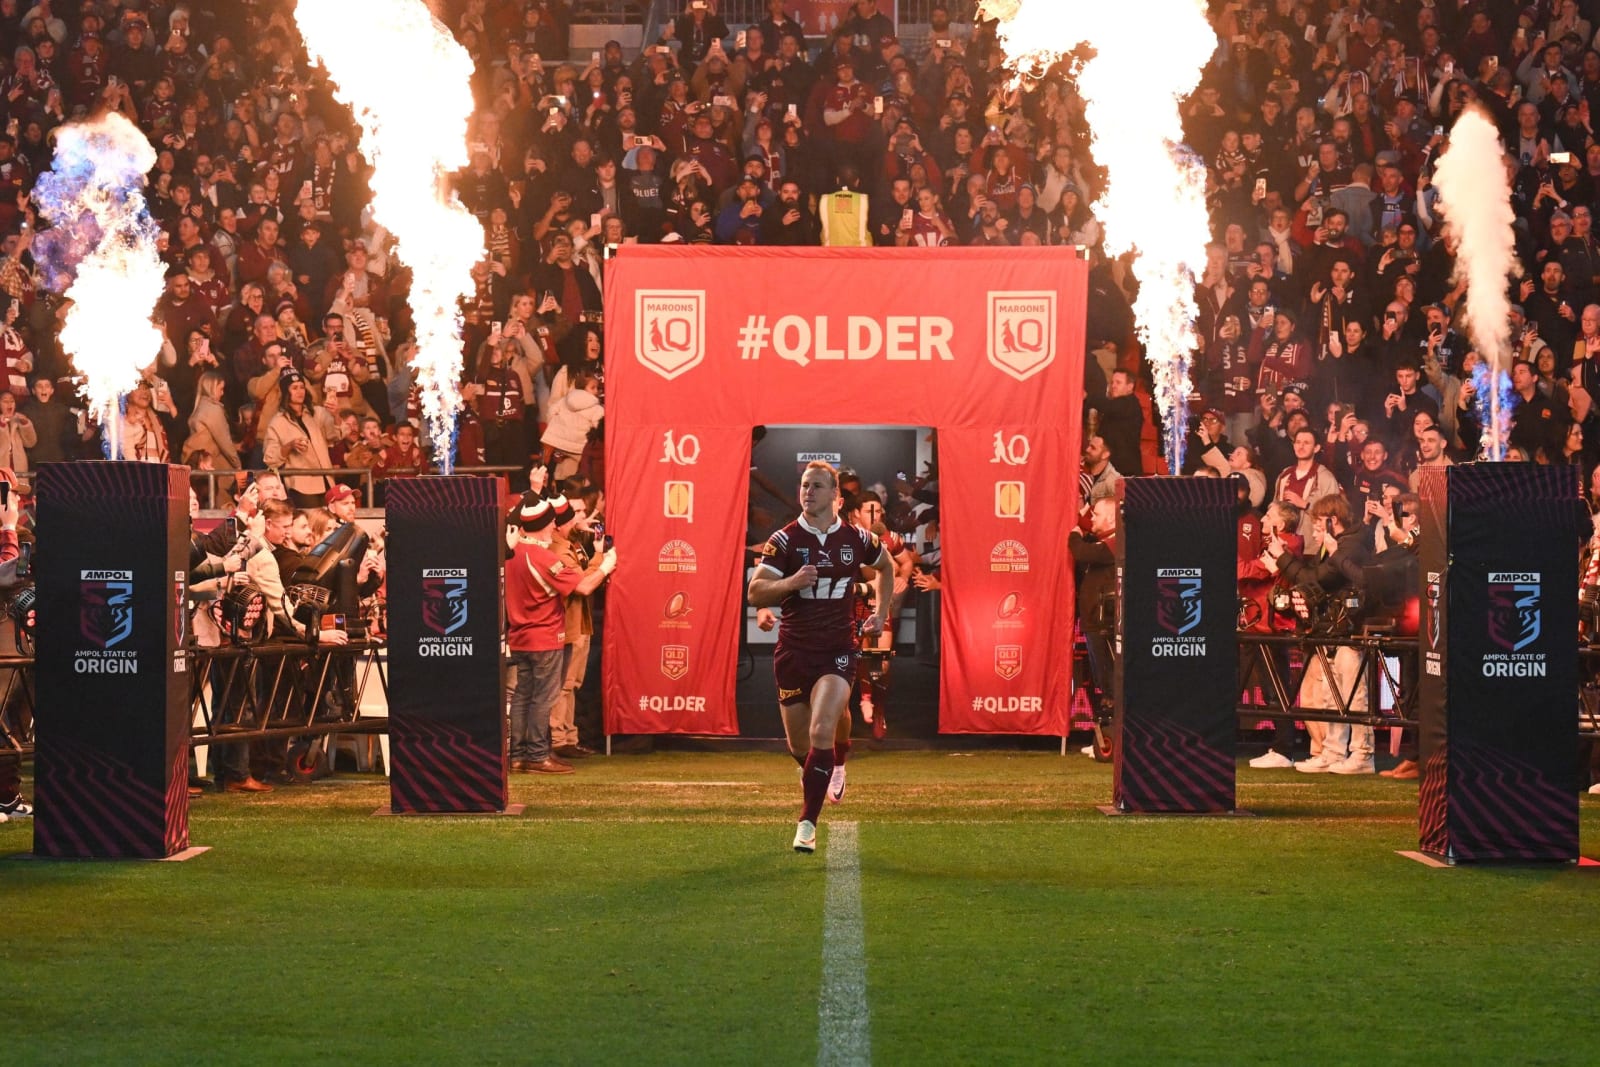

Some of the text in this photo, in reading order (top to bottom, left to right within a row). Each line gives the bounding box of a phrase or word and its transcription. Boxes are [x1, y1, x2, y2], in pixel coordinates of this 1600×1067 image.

[647, 303, 694, 312] MAROONS
[999, 304, 1046, 313] MAROONS
[737, 314, 955, 368] #QLDER
[85, 571, 130, 580] AMPOL
[1492, 573, 1537, 582] AMPOL
[102, 650, 126, 658] STATE
[127, 650, 137, 658] OF
[419, 643, 473, 656] ORIGIN
[665, 650, 684, 659] QLD
[999, 650, 1018, 659] QLD
[1152, 643, 1206, 656] ORIGIN
[74, 658, 138, 674] ORIGIN
[1482, 661, 1547, 677] ORIGIN
[638, 695, 706, 713] #QLDER
[972, 696, 1043, 714] #QLDER
